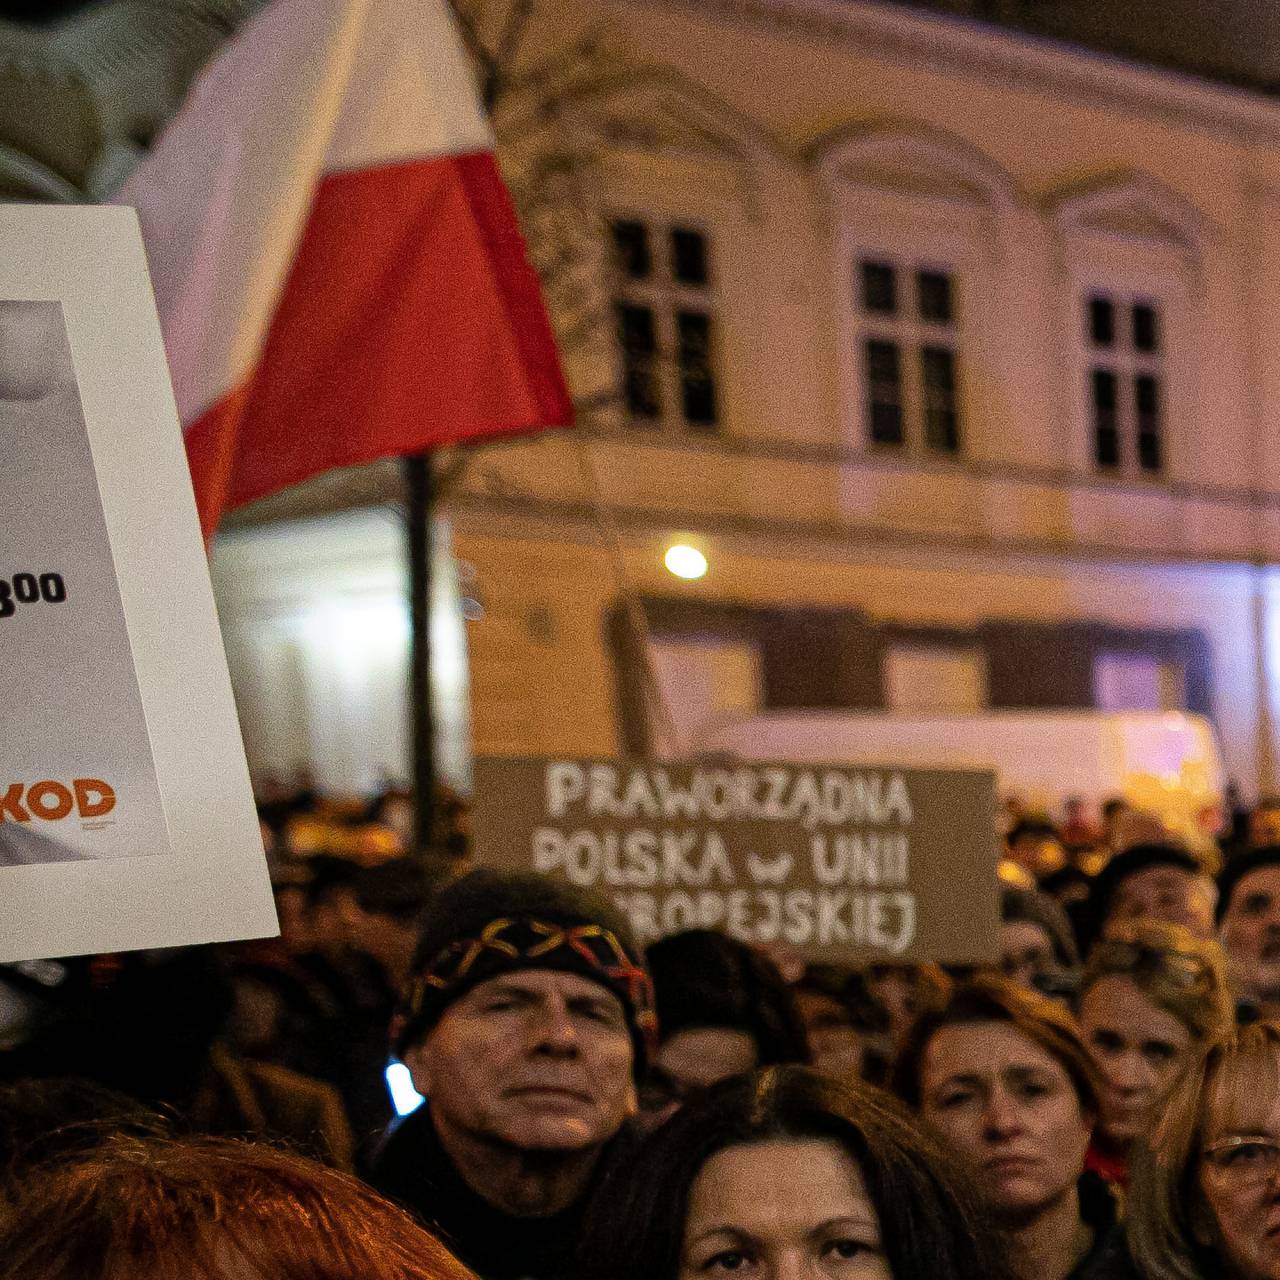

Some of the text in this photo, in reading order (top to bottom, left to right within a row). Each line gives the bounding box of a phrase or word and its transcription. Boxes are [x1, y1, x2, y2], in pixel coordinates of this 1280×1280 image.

[0, 779, 116, 823] KOD
[546, 762, 912, 828] PRAWORZĄDNA
[532, 828, 734, 886] POLSKA
[811, 833, 909, 885] UNII
[613, 888, 917, 954] ROPEJSKIEJ
